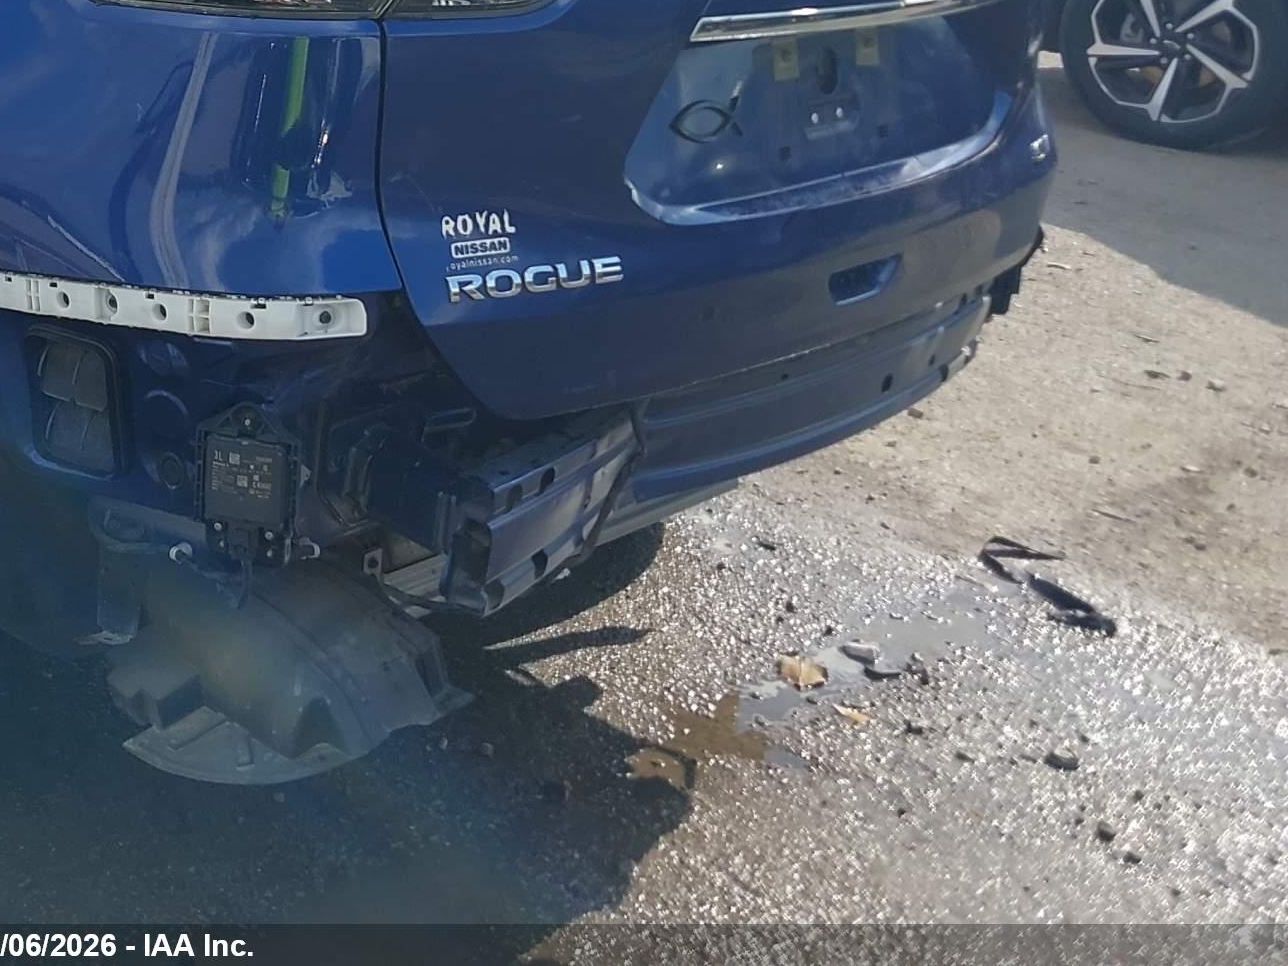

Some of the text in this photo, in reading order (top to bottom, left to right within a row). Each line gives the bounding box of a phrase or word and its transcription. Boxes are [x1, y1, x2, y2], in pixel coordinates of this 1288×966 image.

[442, 208, 516, 238] ROYAL
[454, 239, 508, 256] NISSAN
[445, 255, 624, 302] ROGUE
